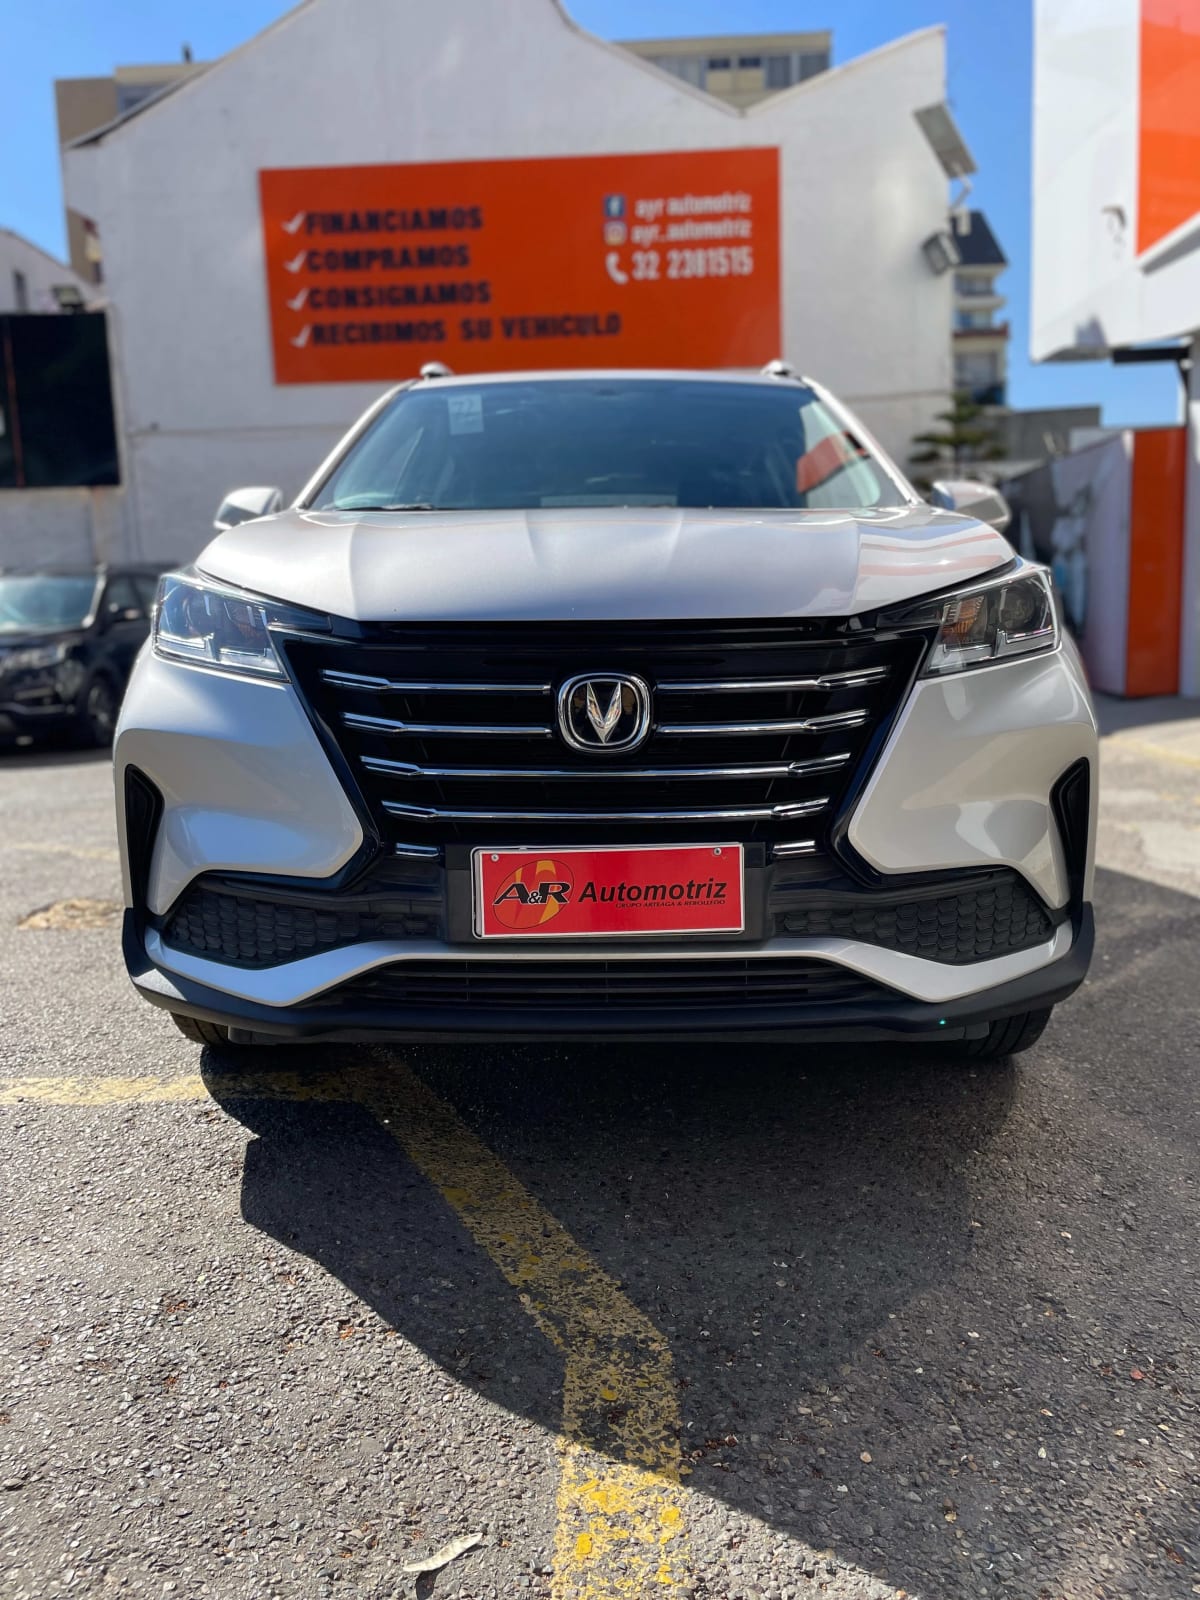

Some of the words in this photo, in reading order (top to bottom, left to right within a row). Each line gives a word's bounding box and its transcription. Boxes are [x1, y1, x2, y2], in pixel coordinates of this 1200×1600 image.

[667, 192, 751, 216] automotriz
[306, 206, 483, 234] FINANCIAMOS
[308, 244, 469, 272] COMPRAMOS
[632, 251, 660, 279] 32
[310, 281, 491, 309] CONSIGNAMOS
[312, 319, 447, 346] RECIBIMOS
[460, 317, 491, 341] SU
[501, 312, 622, 339] VEHICULO
[492, 881, 570, 905] A&R
[578, 877, 728, 903] Automotriz
